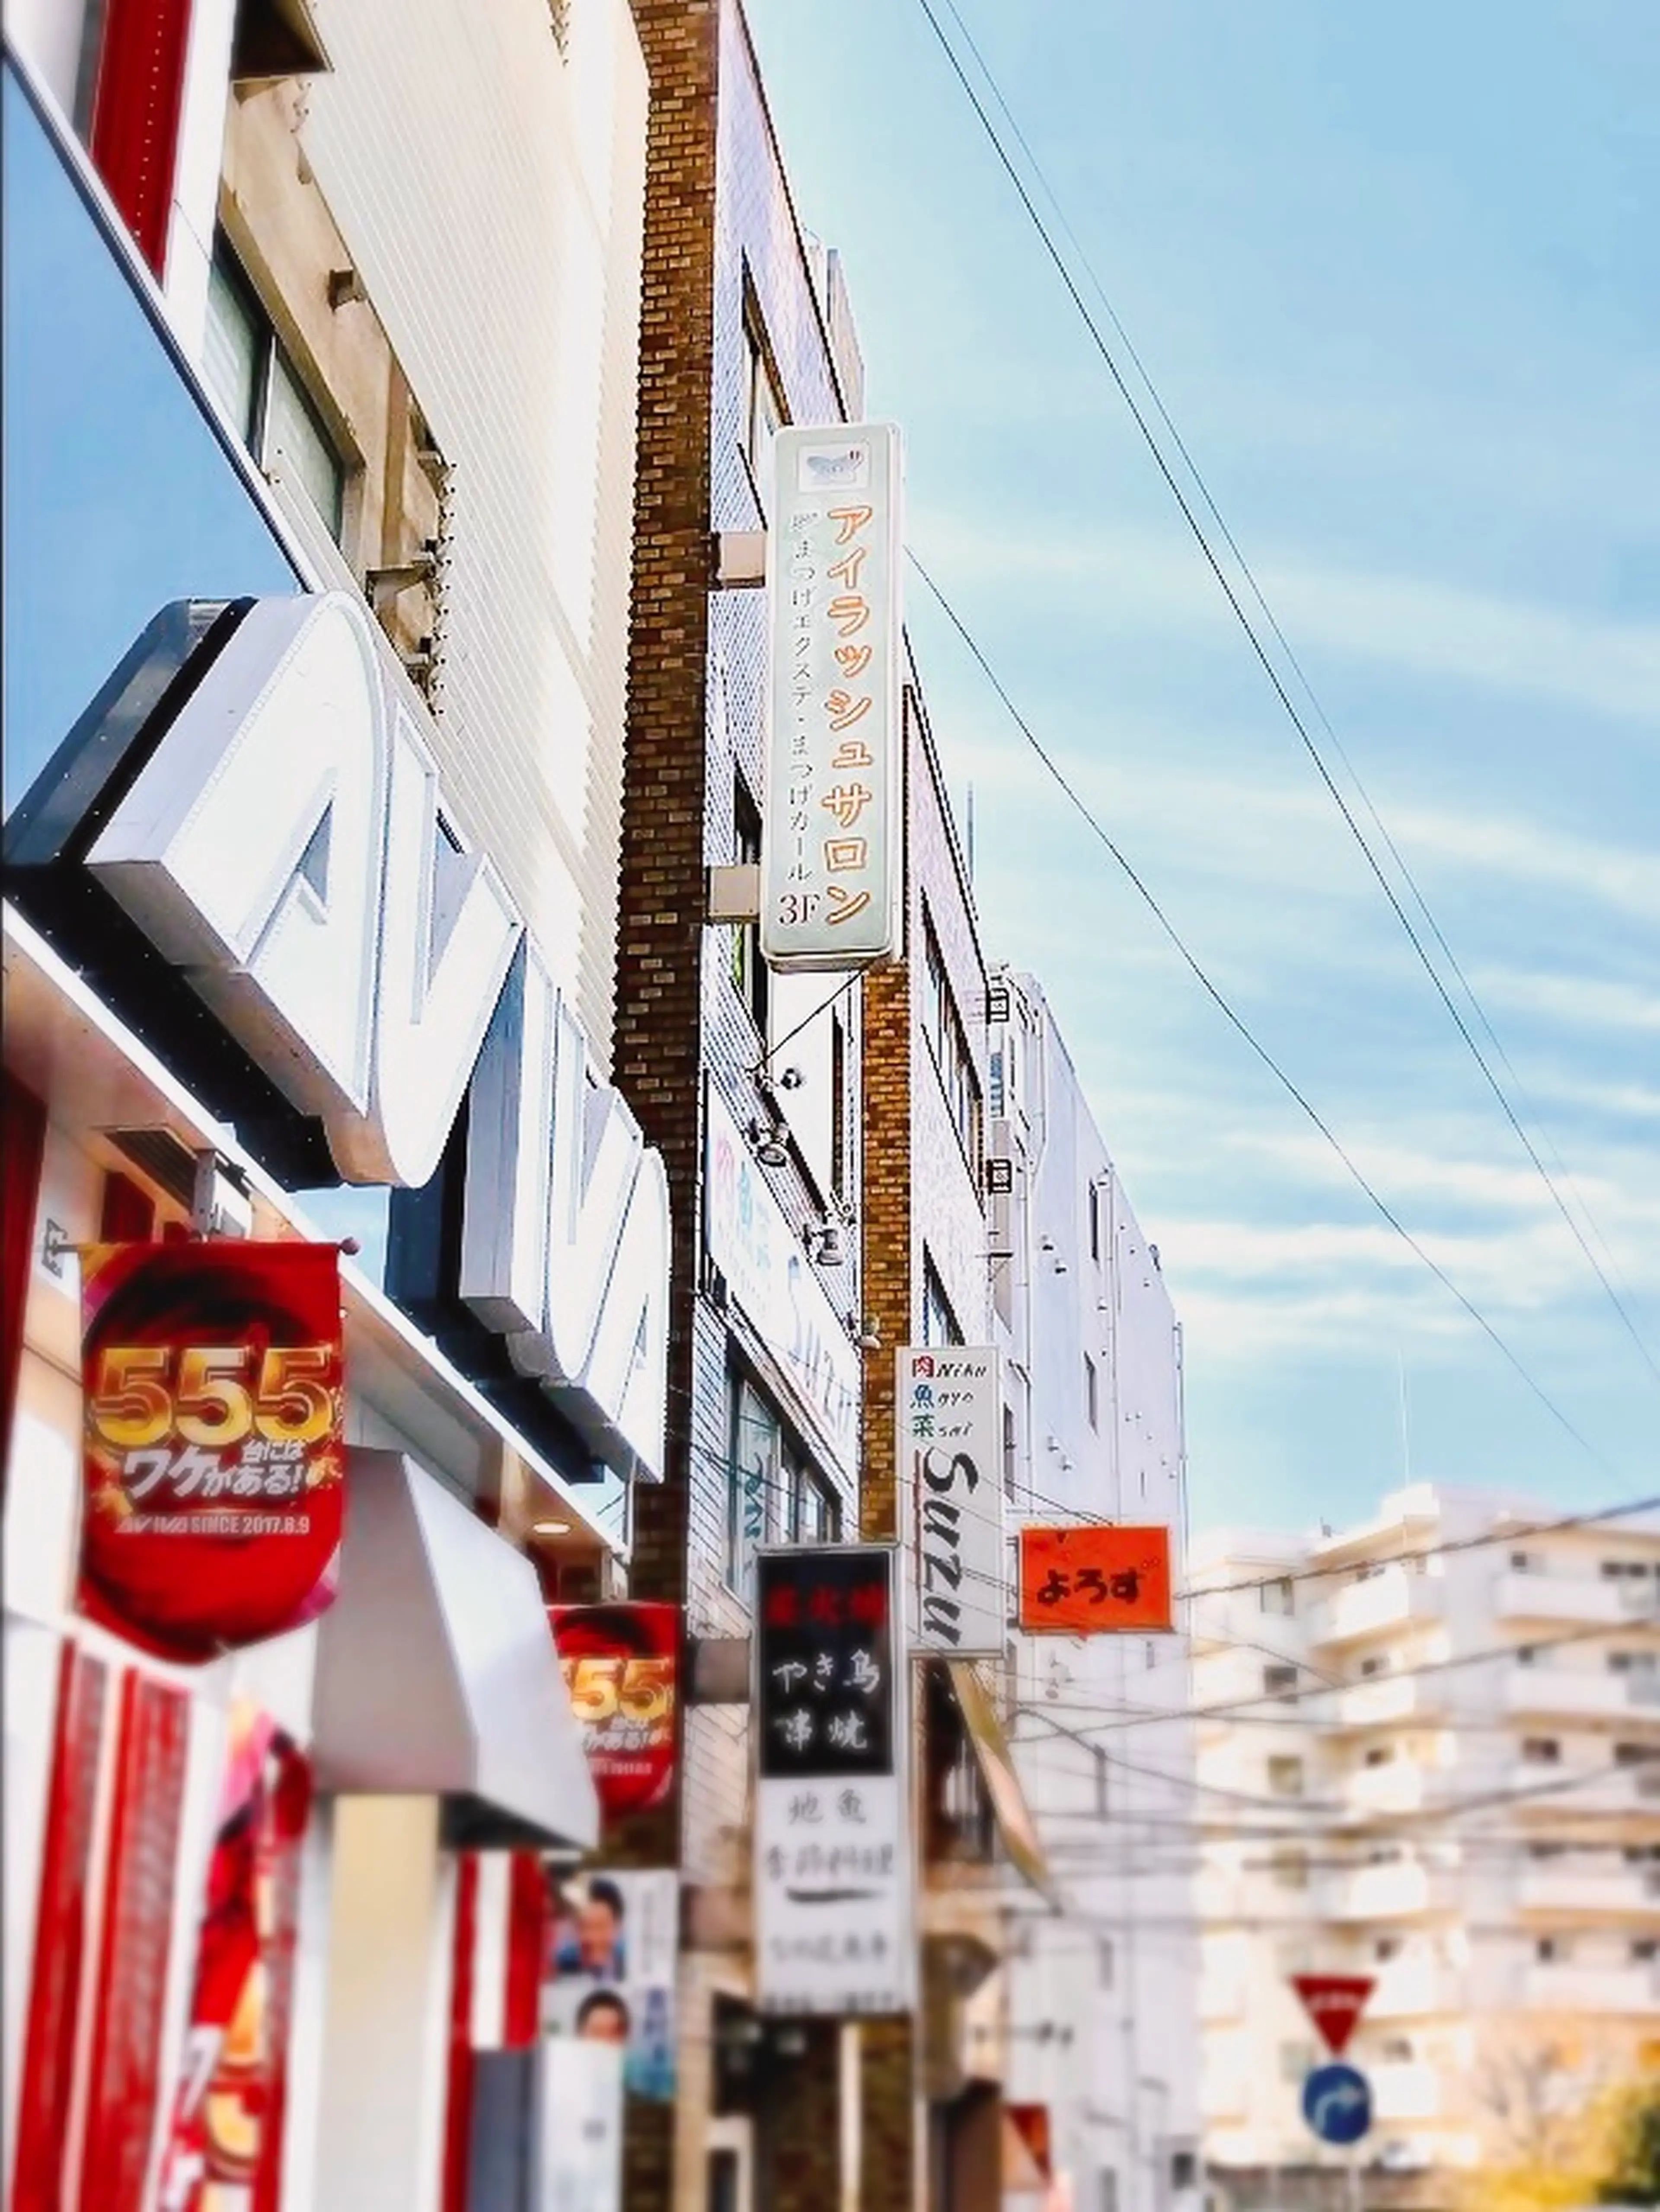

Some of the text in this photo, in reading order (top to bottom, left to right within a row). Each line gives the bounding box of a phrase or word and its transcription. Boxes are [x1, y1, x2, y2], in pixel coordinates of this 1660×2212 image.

[821, 505, 872, 925] アイラッシュサロン
[779, 894, 820, 924] 3F
[913, 1356, 934, 1377] 肉
[94, 1347, 335, 1446] 555
[910, 1384, 935, 1408] 魚
[912, 1413, 935, 1437] 菜
[243, 1439, 306, 1463] 台には
[191, 1516, 239, 1534] SINCE
[923, 1446, 979, 1646] Suzu
[773, 1648, 880, 1693] やき鳥
[562, 1658, 669, 1720] 55
